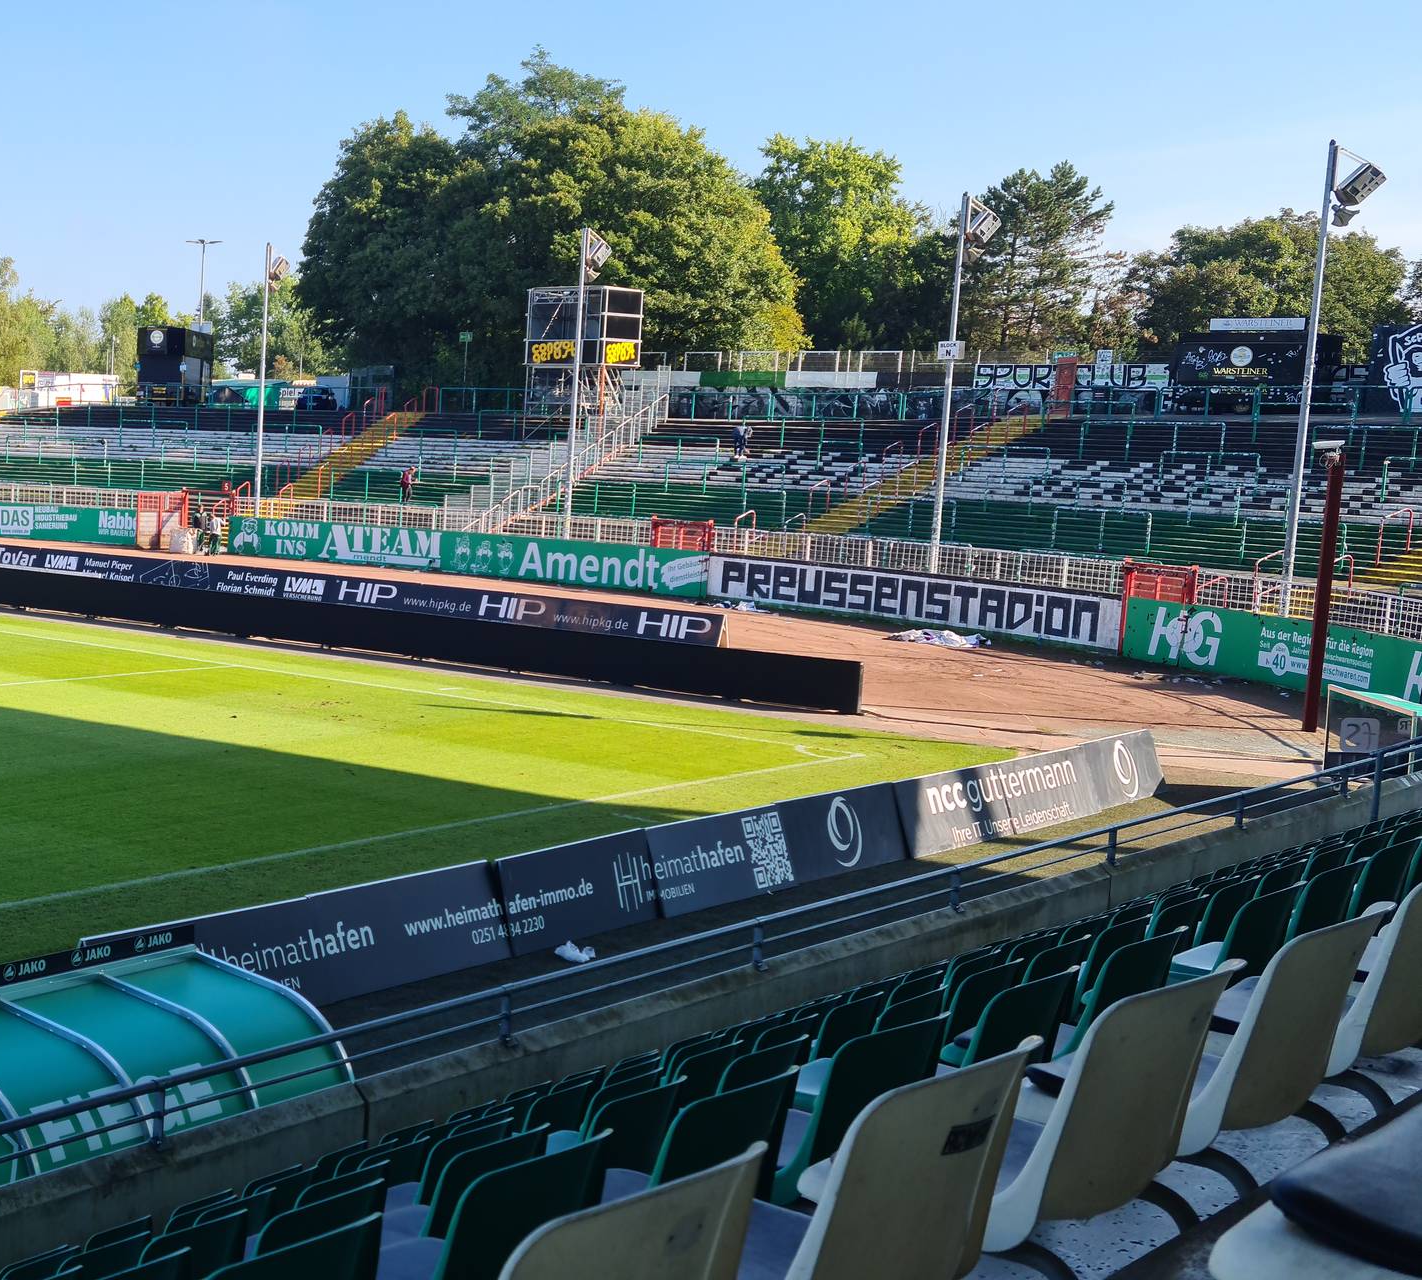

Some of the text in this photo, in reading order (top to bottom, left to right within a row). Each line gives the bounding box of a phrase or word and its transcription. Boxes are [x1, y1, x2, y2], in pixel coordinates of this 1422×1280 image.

[945, 349, 951, 357] N
[1213, 367, 1268, 375] WARSTEINER
[0, 509, 30, 527] DAS
[264, 519, 320, 540] KOMM
[275, 539, 307, 556] INS
[44, 553, 71, 570] LVM
[84, 557, 110, 569] Manuel
[518, 541, 660, 590] Amendt
[227, 569, 278, 586] Paul Everding
[284, 576, 313, 594] LVM
[216, 580, 275, 597] Florian Schmidt
[338, 578, 712, 640] HIP www.hipkg.de HIP www.hipkg.de HIP
[1260, 626, 1276, 639] Aus
[1277, 630, 1291, 641] der
[1338, 639, 1350, 653] die
[1351, 642, 1374, 659] Region
[1272, 653, 1287, 671] 40
[926, 759, 1077, 815] ncc guttermann
[952, 801, 1075, 845] Ihre IT. Unsere Leidenschaft.
[640, 840, 746, 881] heimathafen
[471, 926, 497, 945] 0251
[523, 914, 545, 934] 2230
[147, 931, 173, 949] JAKO
[222, 920, 376, 974] heimathafen
[84, 944, 112, 962] JAKO
[17, 958, 47, 977] JAKO
